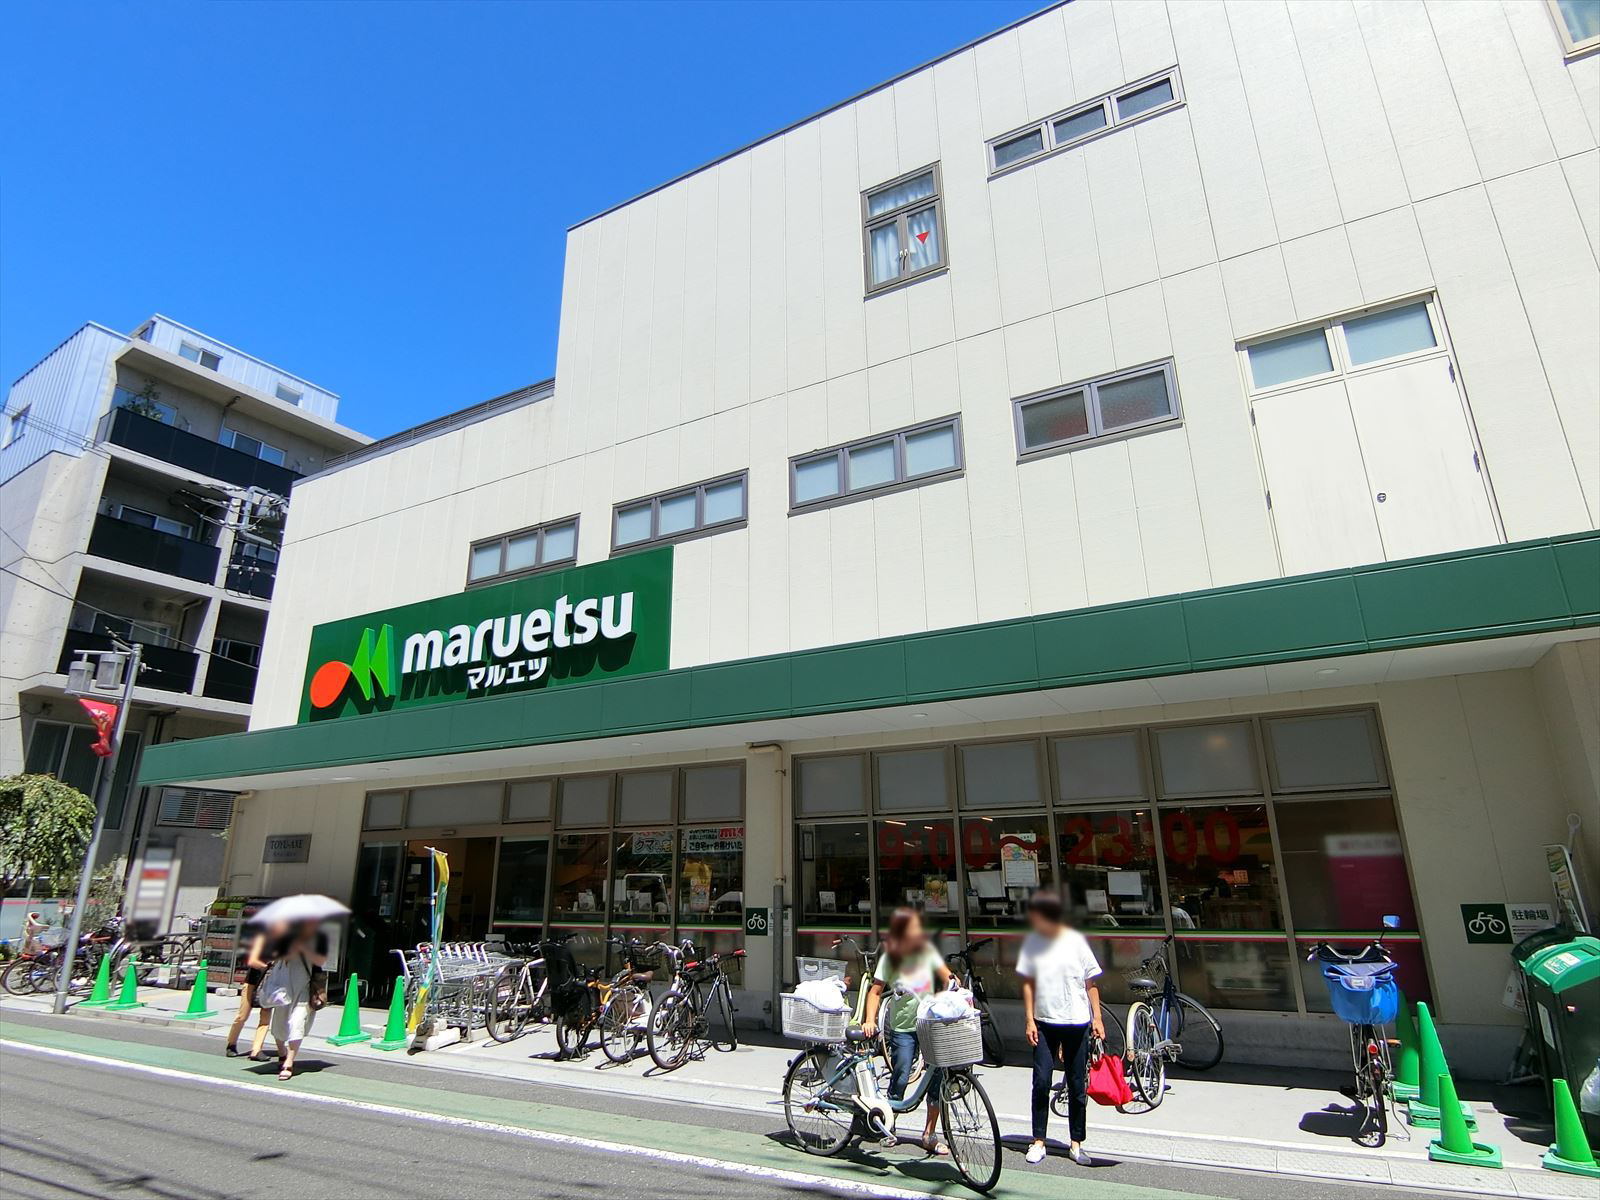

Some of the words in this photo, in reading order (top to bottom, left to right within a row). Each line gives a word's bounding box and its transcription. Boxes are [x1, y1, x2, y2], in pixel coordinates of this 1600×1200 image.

[401, 591, 634, 674] maruetsu
[466, 656, 550, 690] マルエツ
[1511, 909, 1549, 921] 駐輪場
